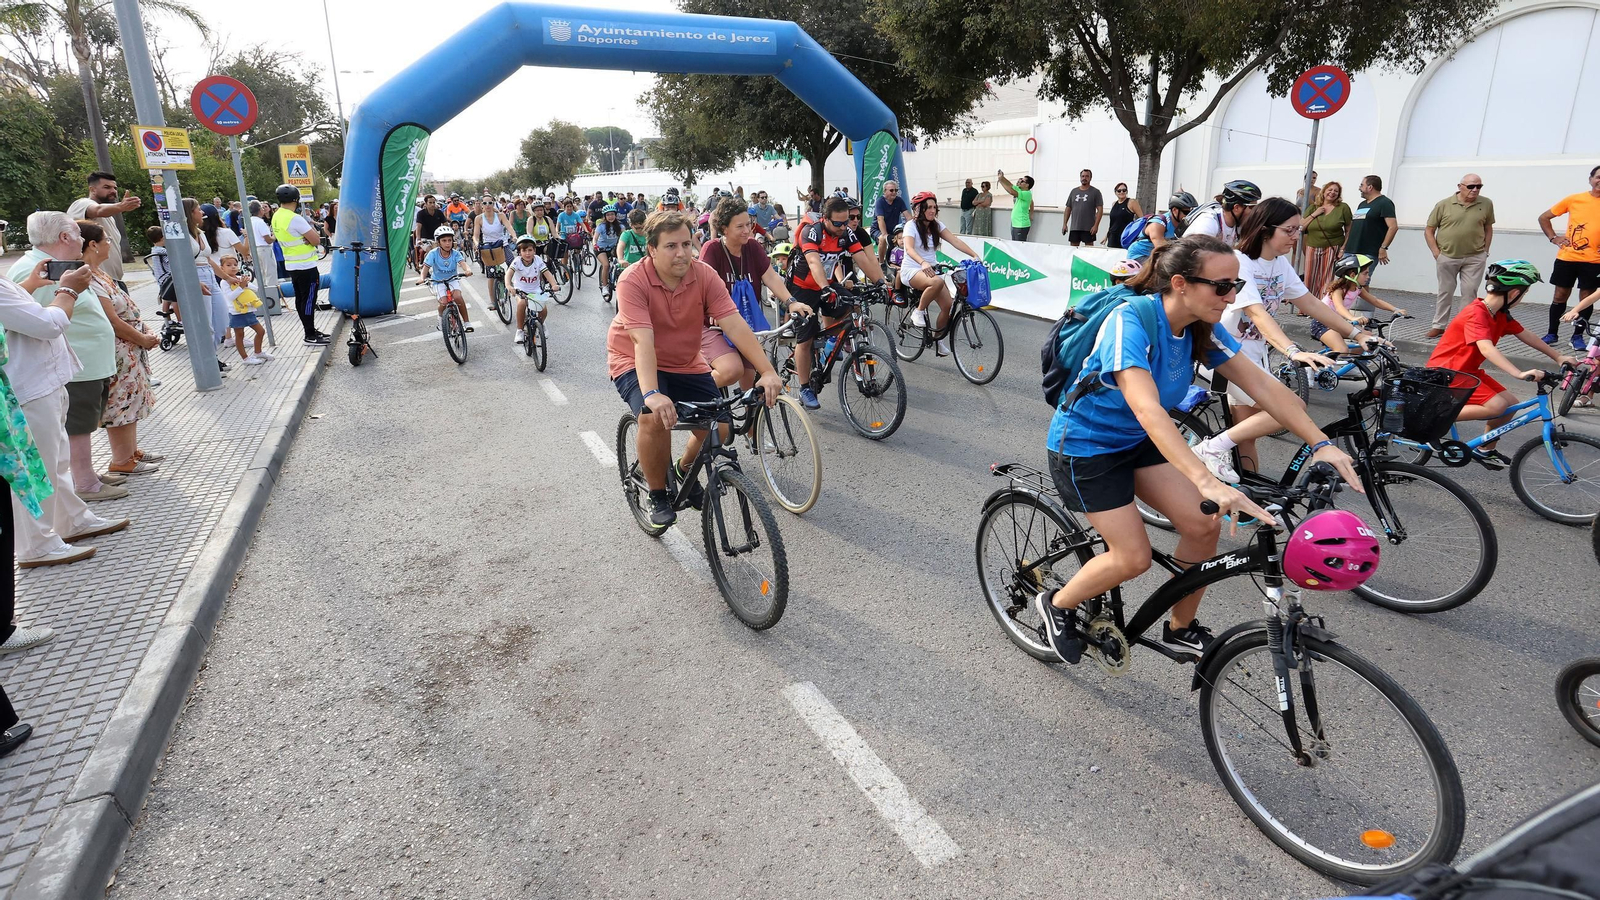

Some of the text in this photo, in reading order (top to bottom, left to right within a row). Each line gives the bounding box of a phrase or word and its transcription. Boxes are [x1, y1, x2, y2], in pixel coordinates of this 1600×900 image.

[577, 24, 770, 43] Ayuntamiento de Jerez
[577, 35, 638, 45] Deportes
